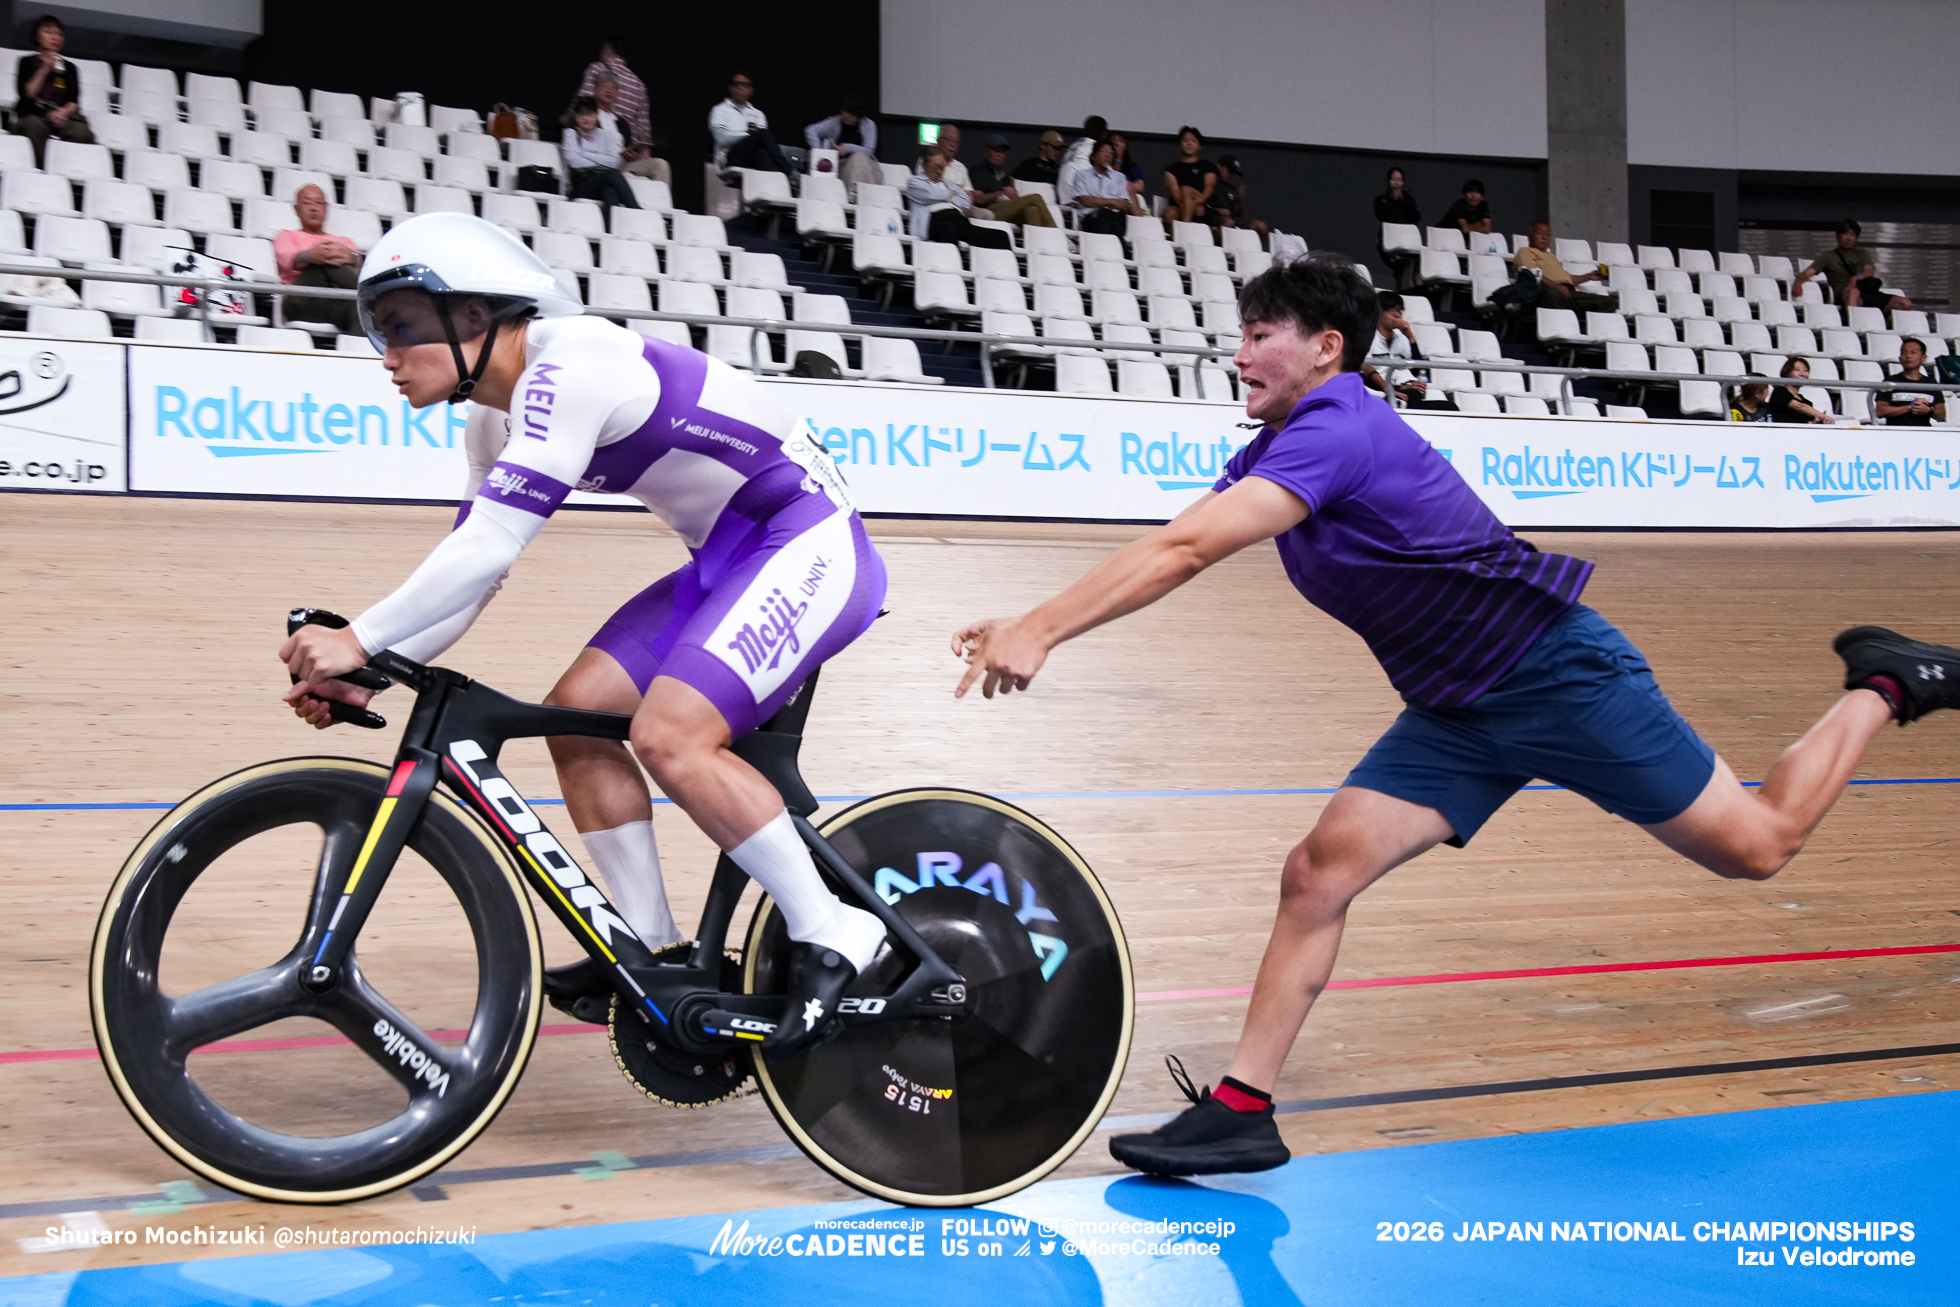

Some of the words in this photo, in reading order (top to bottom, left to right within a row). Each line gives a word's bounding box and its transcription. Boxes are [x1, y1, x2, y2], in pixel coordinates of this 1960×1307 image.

[465, 265, 556, 290] LAZER
[156, 385, 389, 446] Rakuten
[524, 363, 565, 443] MEIJI
[684, 423, 710, 438] MEIJI
[709, 430, 760, 456] UNIVERSITY
[887, 423, 1091, 473] Kドリームス
[487, 466, 528, 496] Meiji
[1481, 445, 1616, 488] Rakuten
[1621, 451, 1766, 489] Kドリームス
[1784, 453, 1898, 491] Rakuten
[727, 588, 808, 676] Meiji
[799, 555, 832, 597] UNIV.
[449, 739, 640, 946] LOOK
[874, 851, 1069, 983] ARAYA
[373, 1019, 450, 1099] Velobike
[882, 1064, 909, 1089] Tokyo
[884, 1084, 931, 1115] 1515
[910, 1081, 954, 1100] ARAYA
